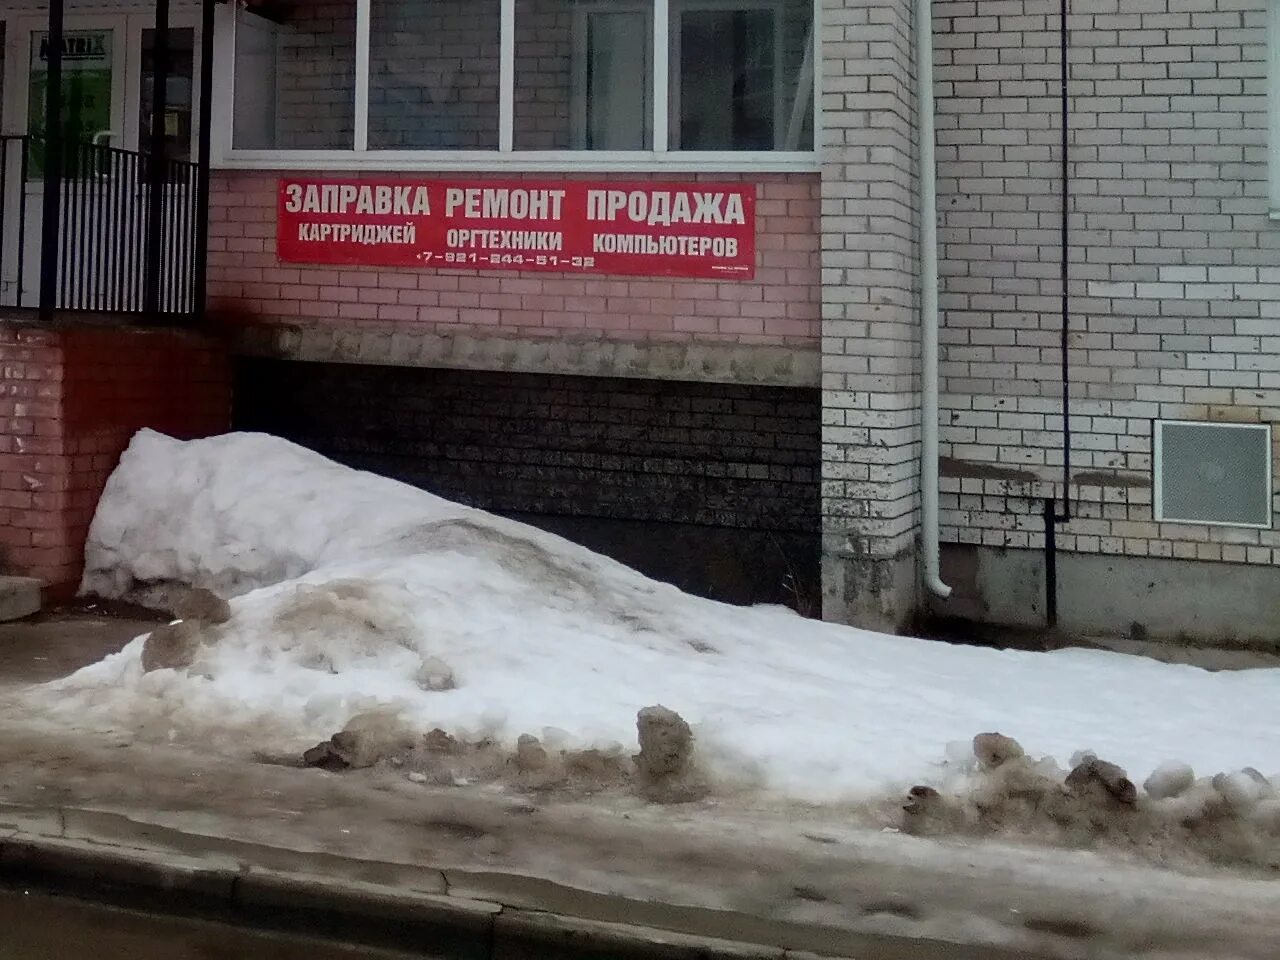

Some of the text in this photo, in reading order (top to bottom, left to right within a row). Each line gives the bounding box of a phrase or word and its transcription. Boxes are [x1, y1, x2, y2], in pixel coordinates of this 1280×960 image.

[285, 184, 746, 226] ЗАПРАВКА РЕМОНТ ПРОДАЖА
[298, 221, 738, 257] КАРТРИДЖЕЙ ОРГТЕХНИКИ КОМПЬЮТЕРОВ
